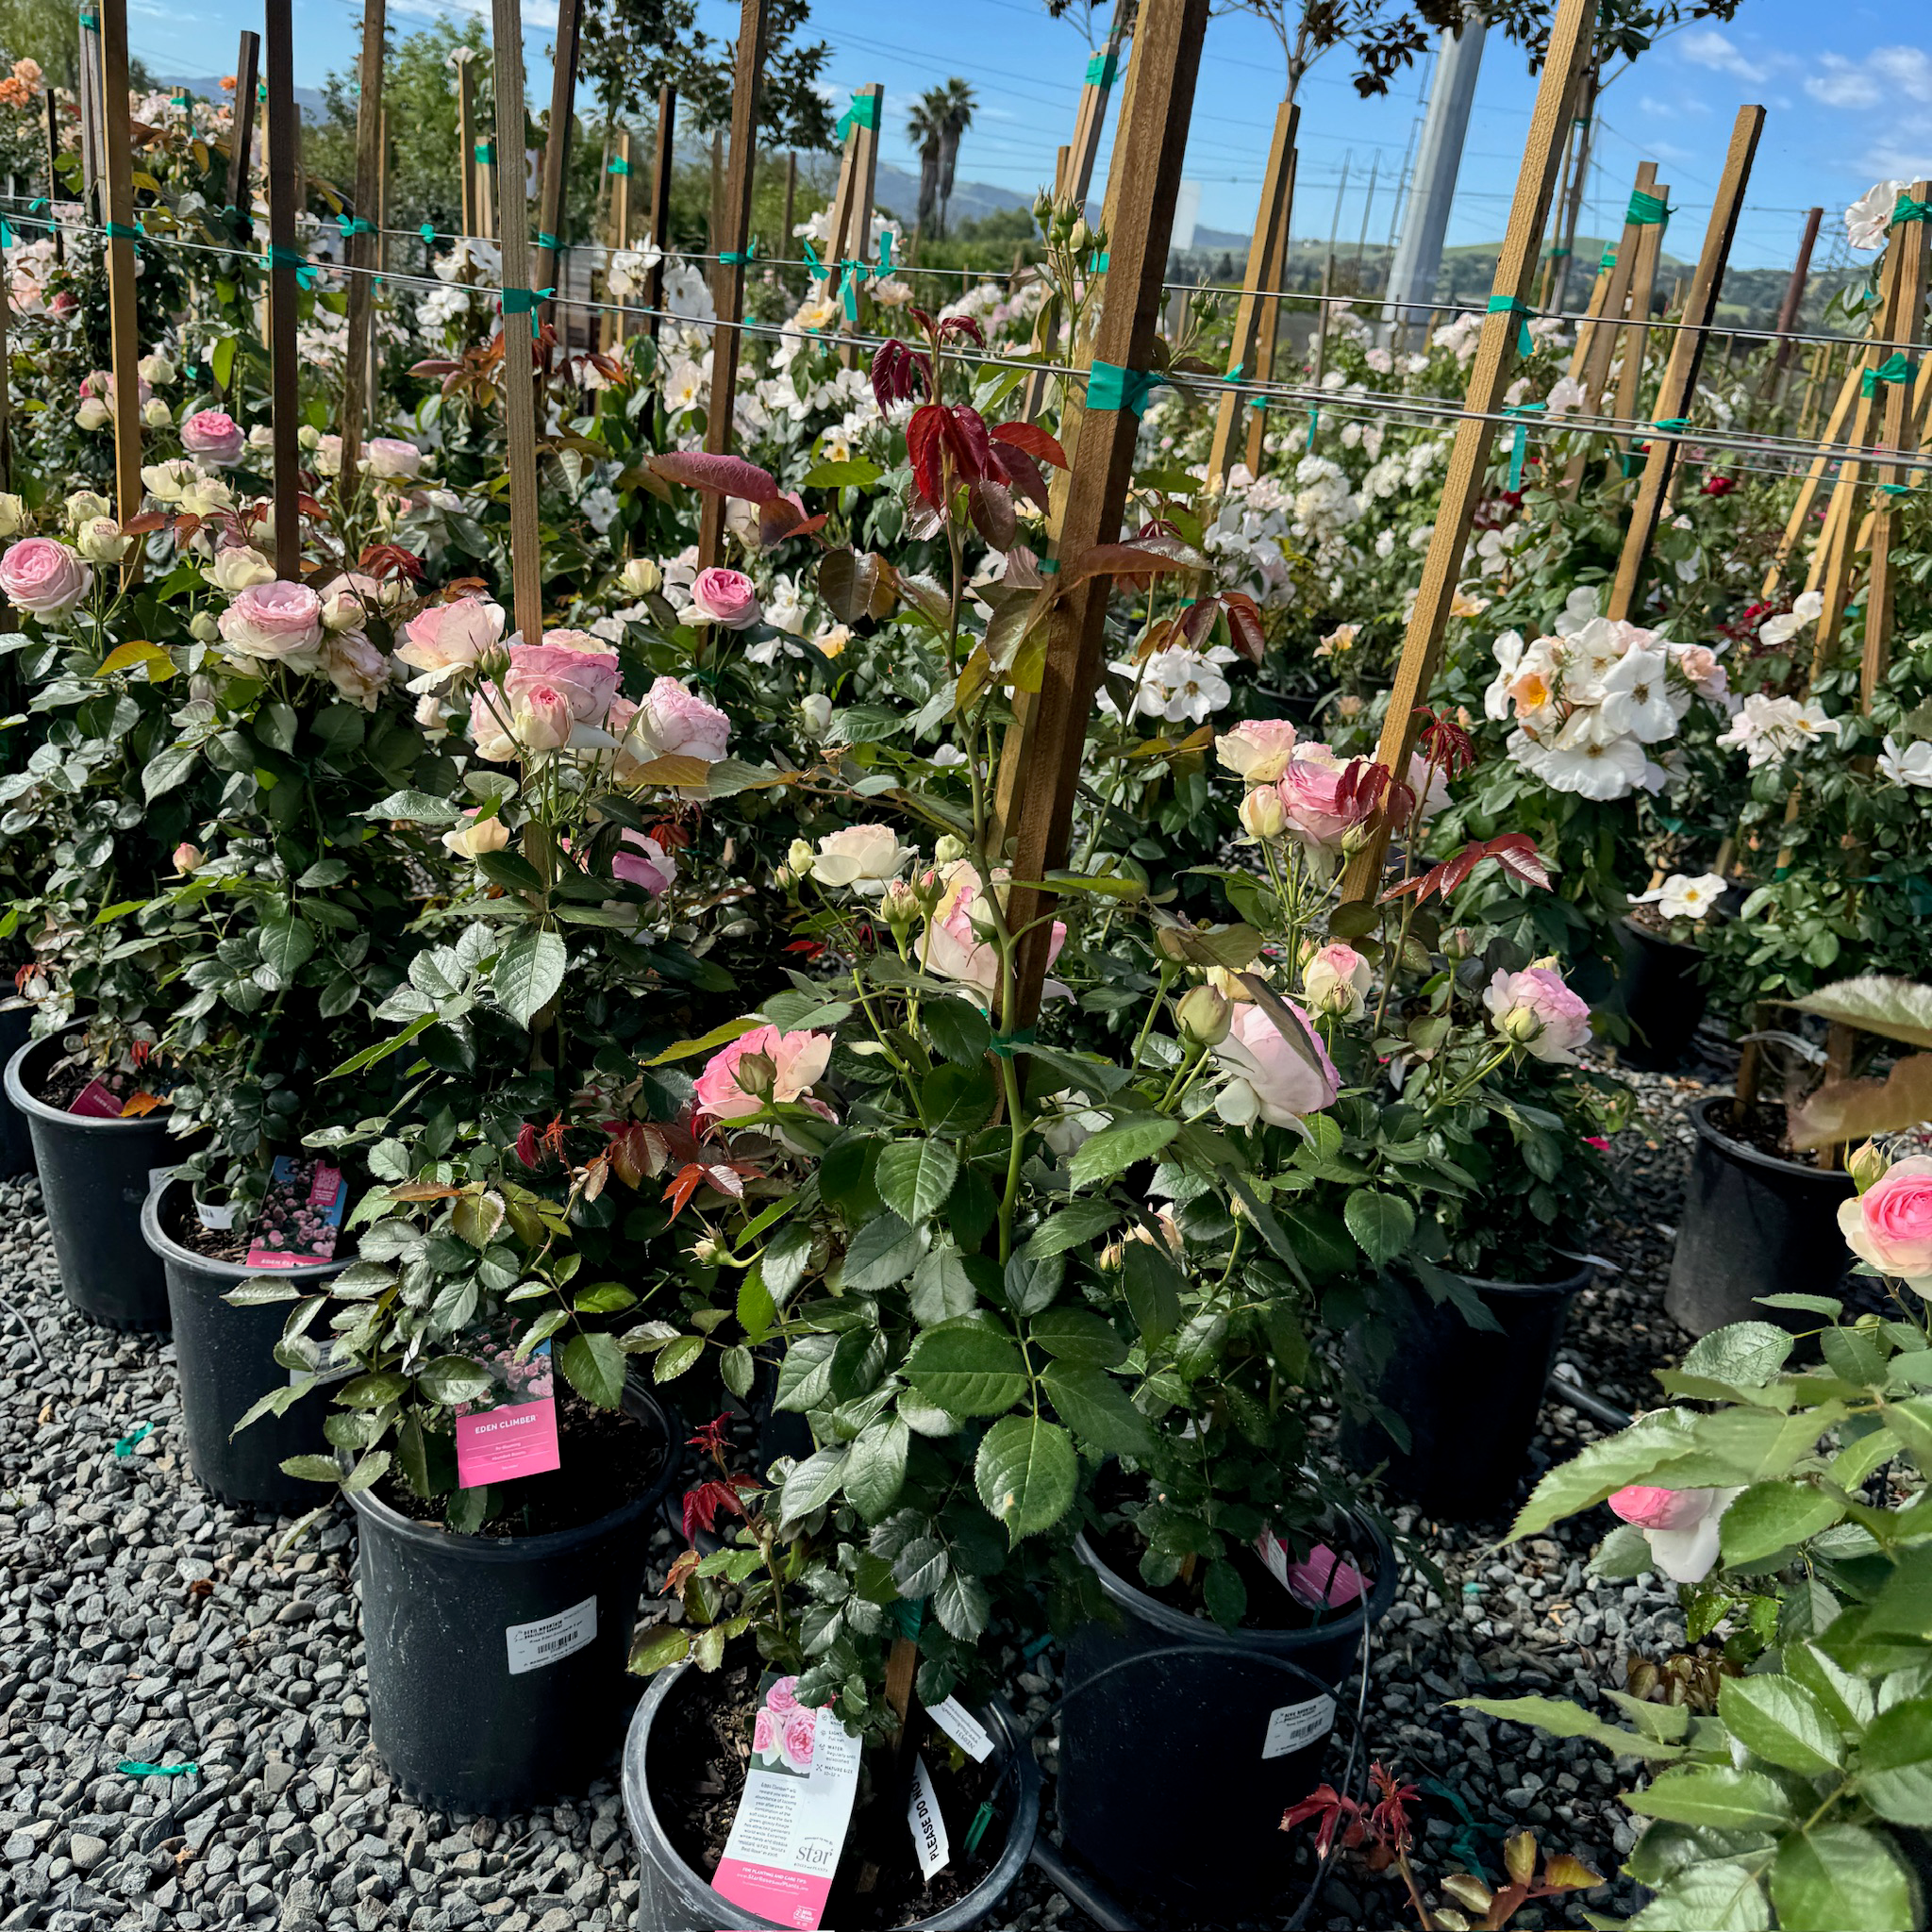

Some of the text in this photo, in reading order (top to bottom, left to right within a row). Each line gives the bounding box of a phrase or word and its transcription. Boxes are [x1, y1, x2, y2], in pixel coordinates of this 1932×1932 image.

[475, 1414, 537, 1435] EDEN CLIMBER
[916, 1800, 929, 1819] DO
[921, 1817, 940, 1861] PLEASE
[795, 1842, 833, 1865] star
[751, 1868, 774, 1878] PLANTING
